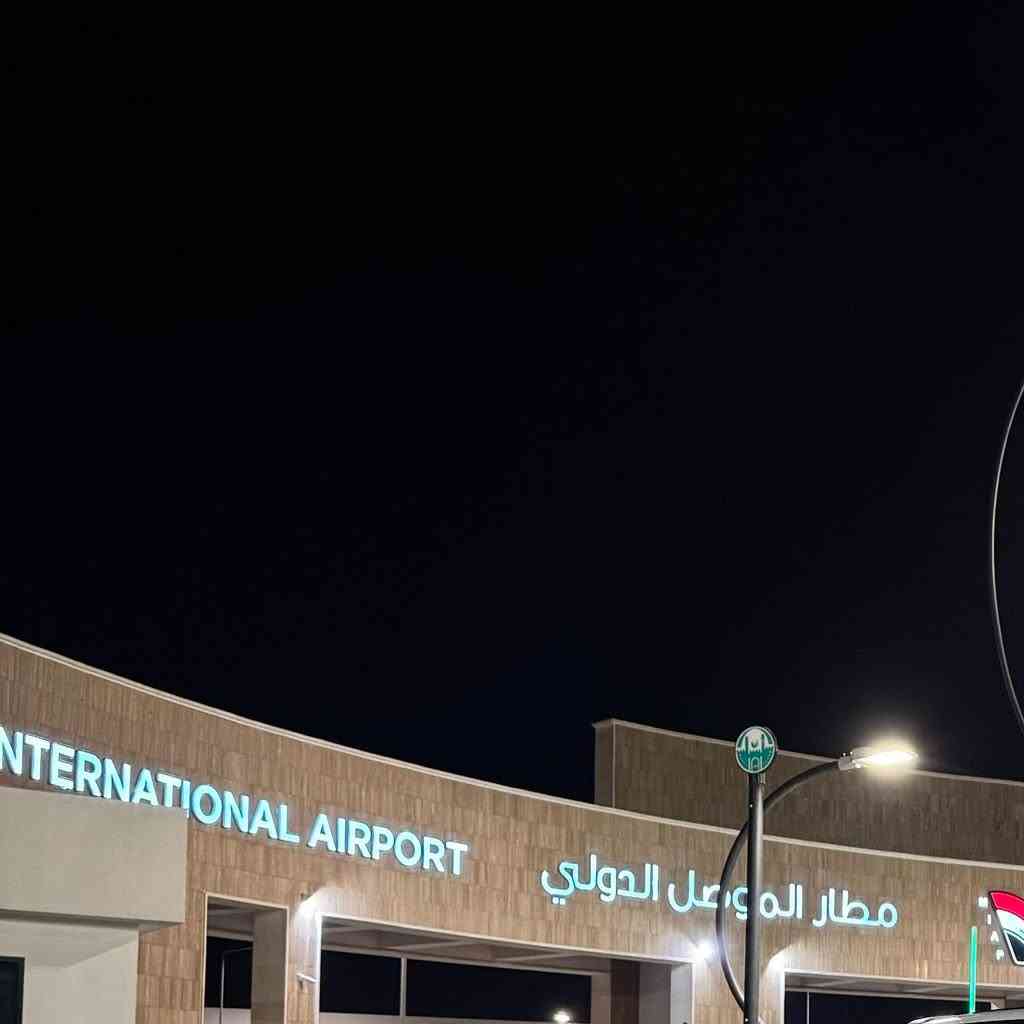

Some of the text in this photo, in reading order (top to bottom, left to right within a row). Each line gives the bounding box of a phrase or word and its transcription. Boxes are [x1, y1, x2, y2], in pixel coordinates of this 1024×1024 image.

[0, 726, 468, 875] NTERNATIONAL AIRPORT
[541, 854, 658, 905] الدولي
[812, 887, 898, 927] مطار
